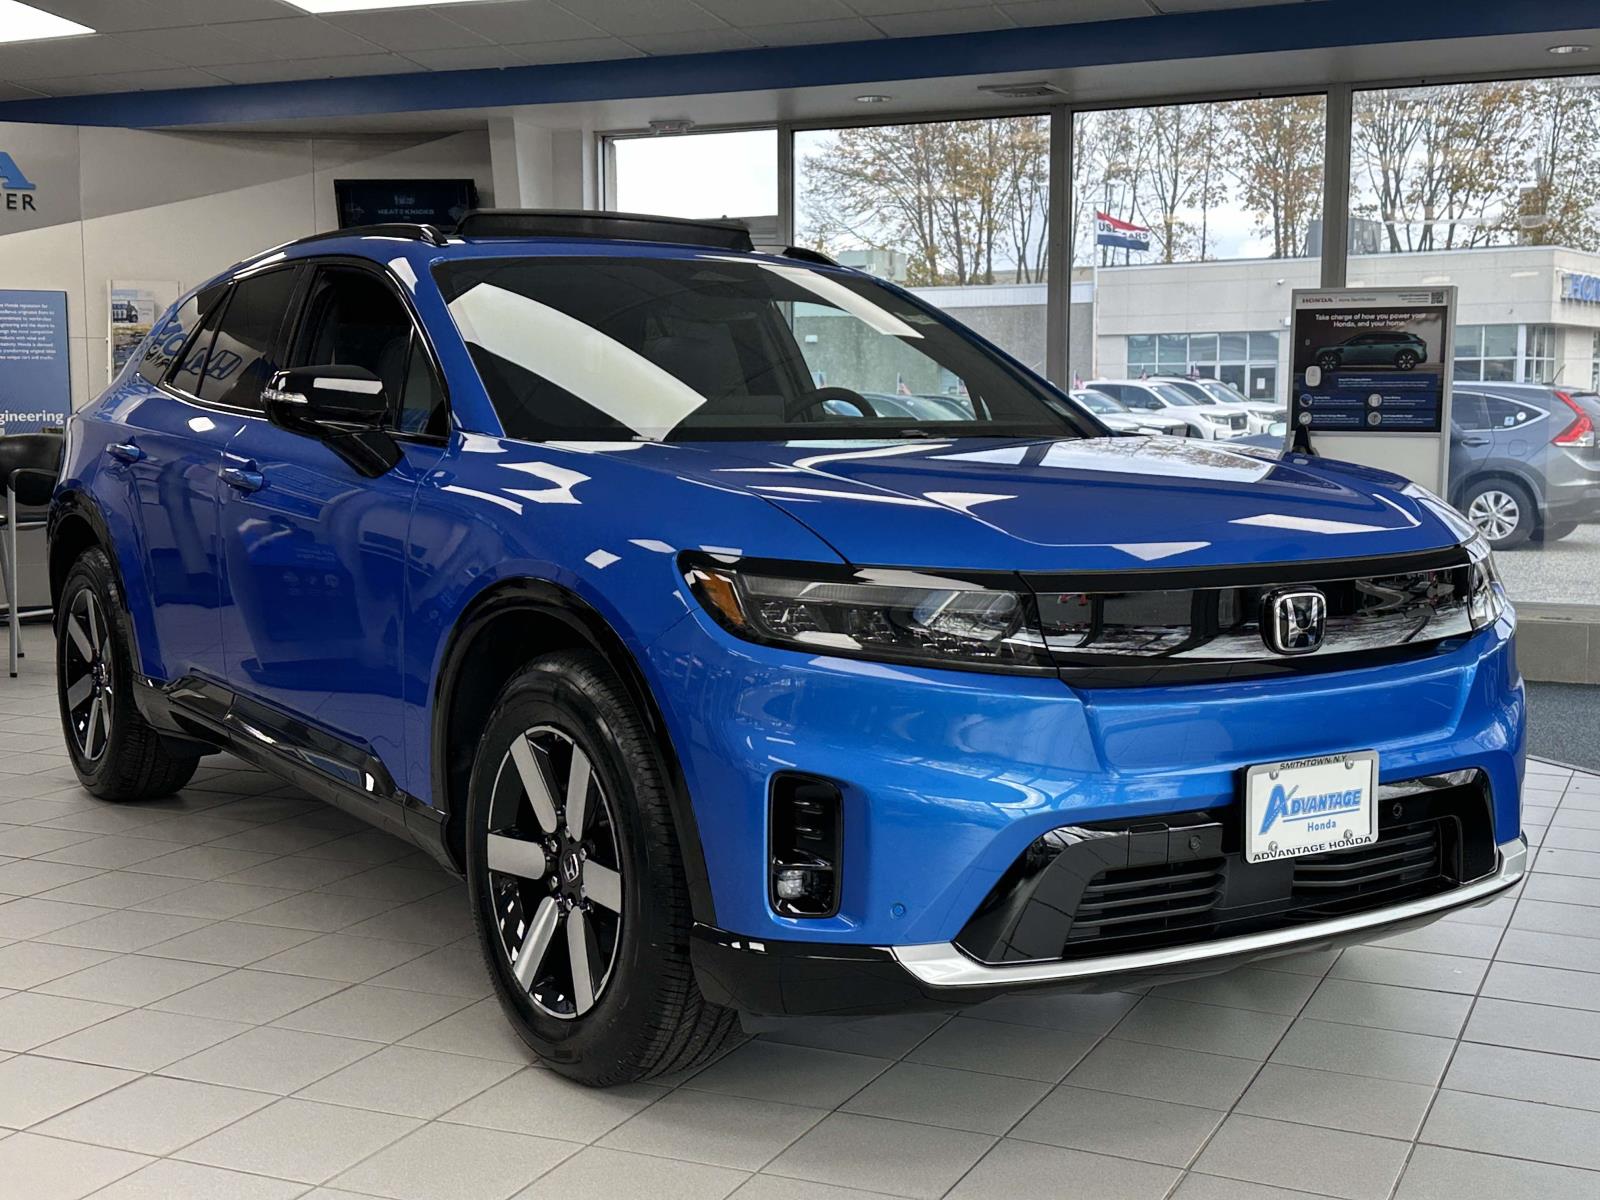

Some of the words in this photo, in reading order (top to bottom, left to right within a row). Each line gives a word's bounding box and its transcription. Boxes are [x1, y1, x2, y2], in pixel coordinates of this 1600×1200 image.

[0, 193, 36, 211] ER
[1308, 818, 1336, 832] Honda
[1253, 843, 1326, 862] ADVANTAGE
[1329, 836, 1372, 849] HONDA
